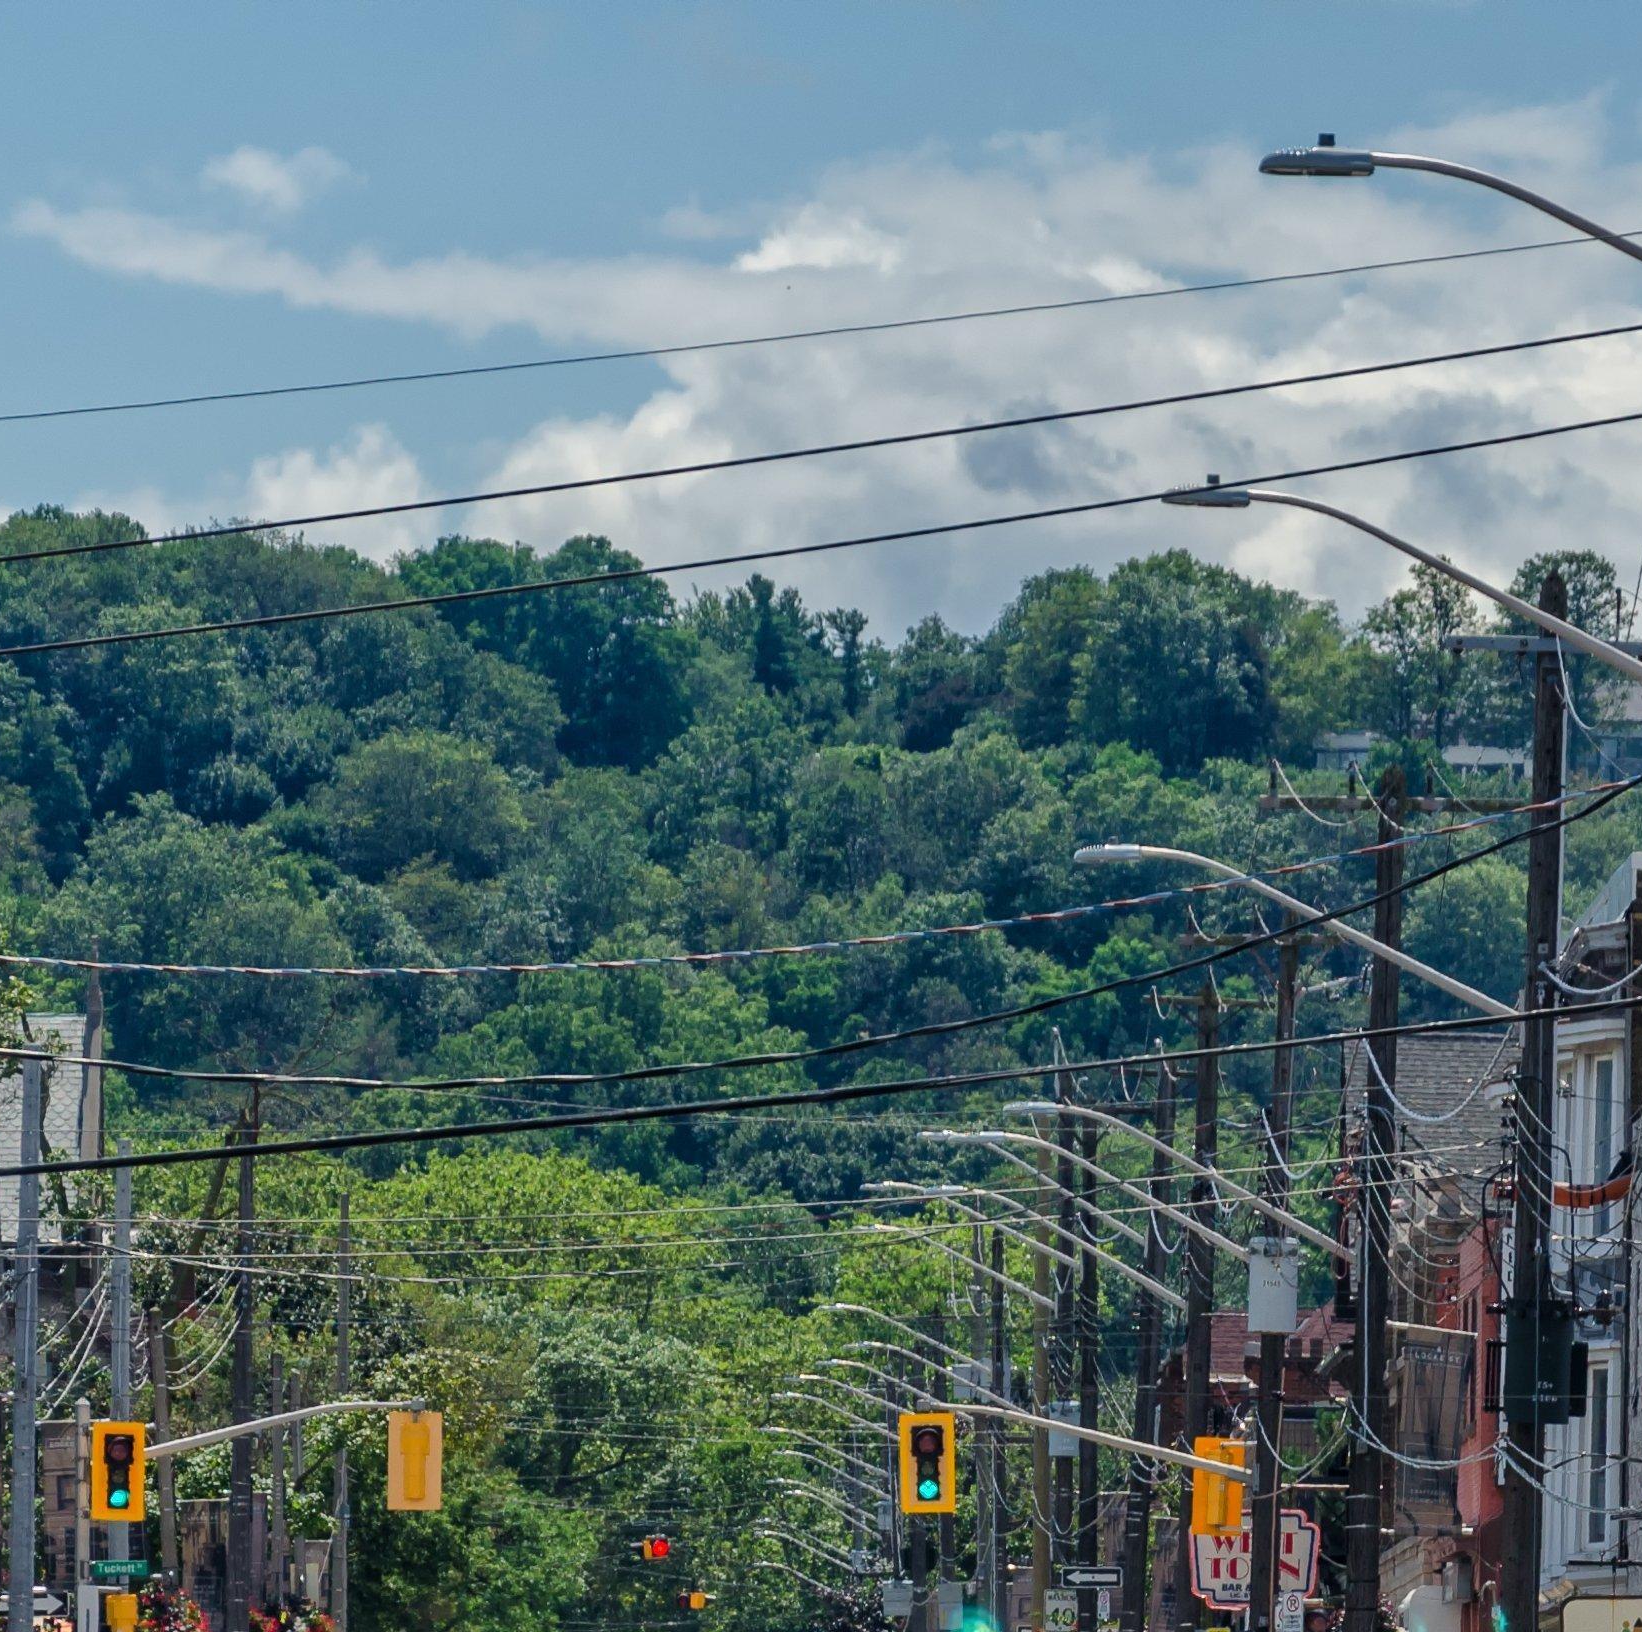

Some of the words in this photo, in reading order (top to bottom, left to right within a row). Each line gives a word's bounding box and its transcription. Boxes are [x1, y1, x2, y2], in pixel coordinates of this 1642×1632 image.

[1210, 1531, 1300, 1555] WET
[97, 1562, 136, 1574] Tuckett
[1205, 1556, 1301, 1581] TON
[1221, 1583, 1243, 1592] BAR
